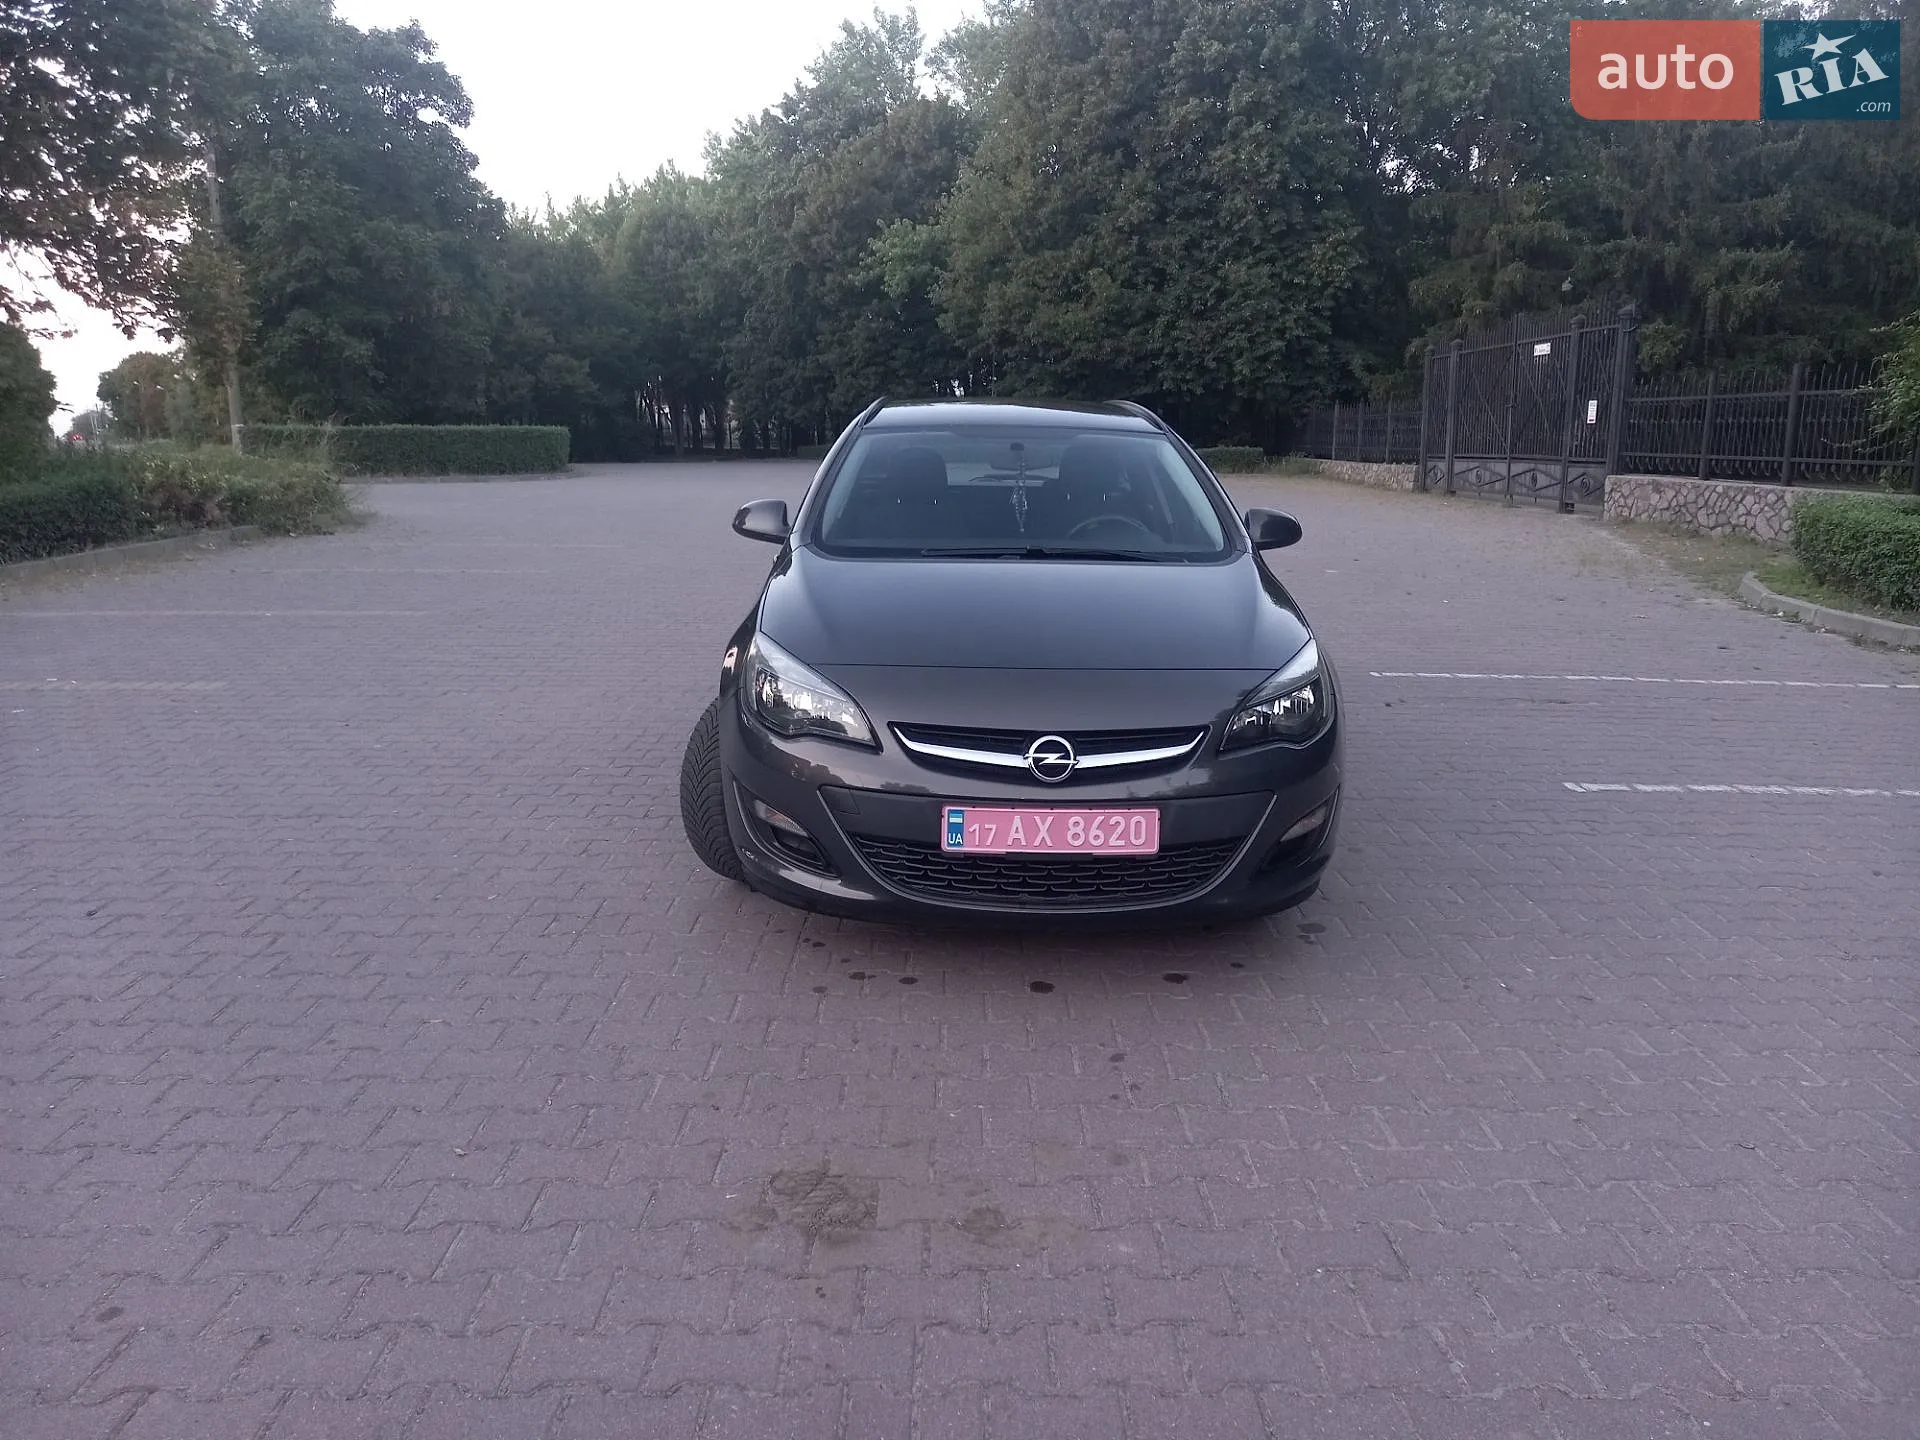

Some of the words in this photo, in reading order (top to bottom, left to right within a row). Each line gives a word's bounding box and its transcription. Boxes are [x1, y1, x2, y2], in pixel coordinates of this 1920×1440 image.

[948, 832, 963, 845] UA
[968, 823, 998, 846] 17
[1007, 815, 1054, 847] AX
[1067, 815, 1147, 847] 8620
